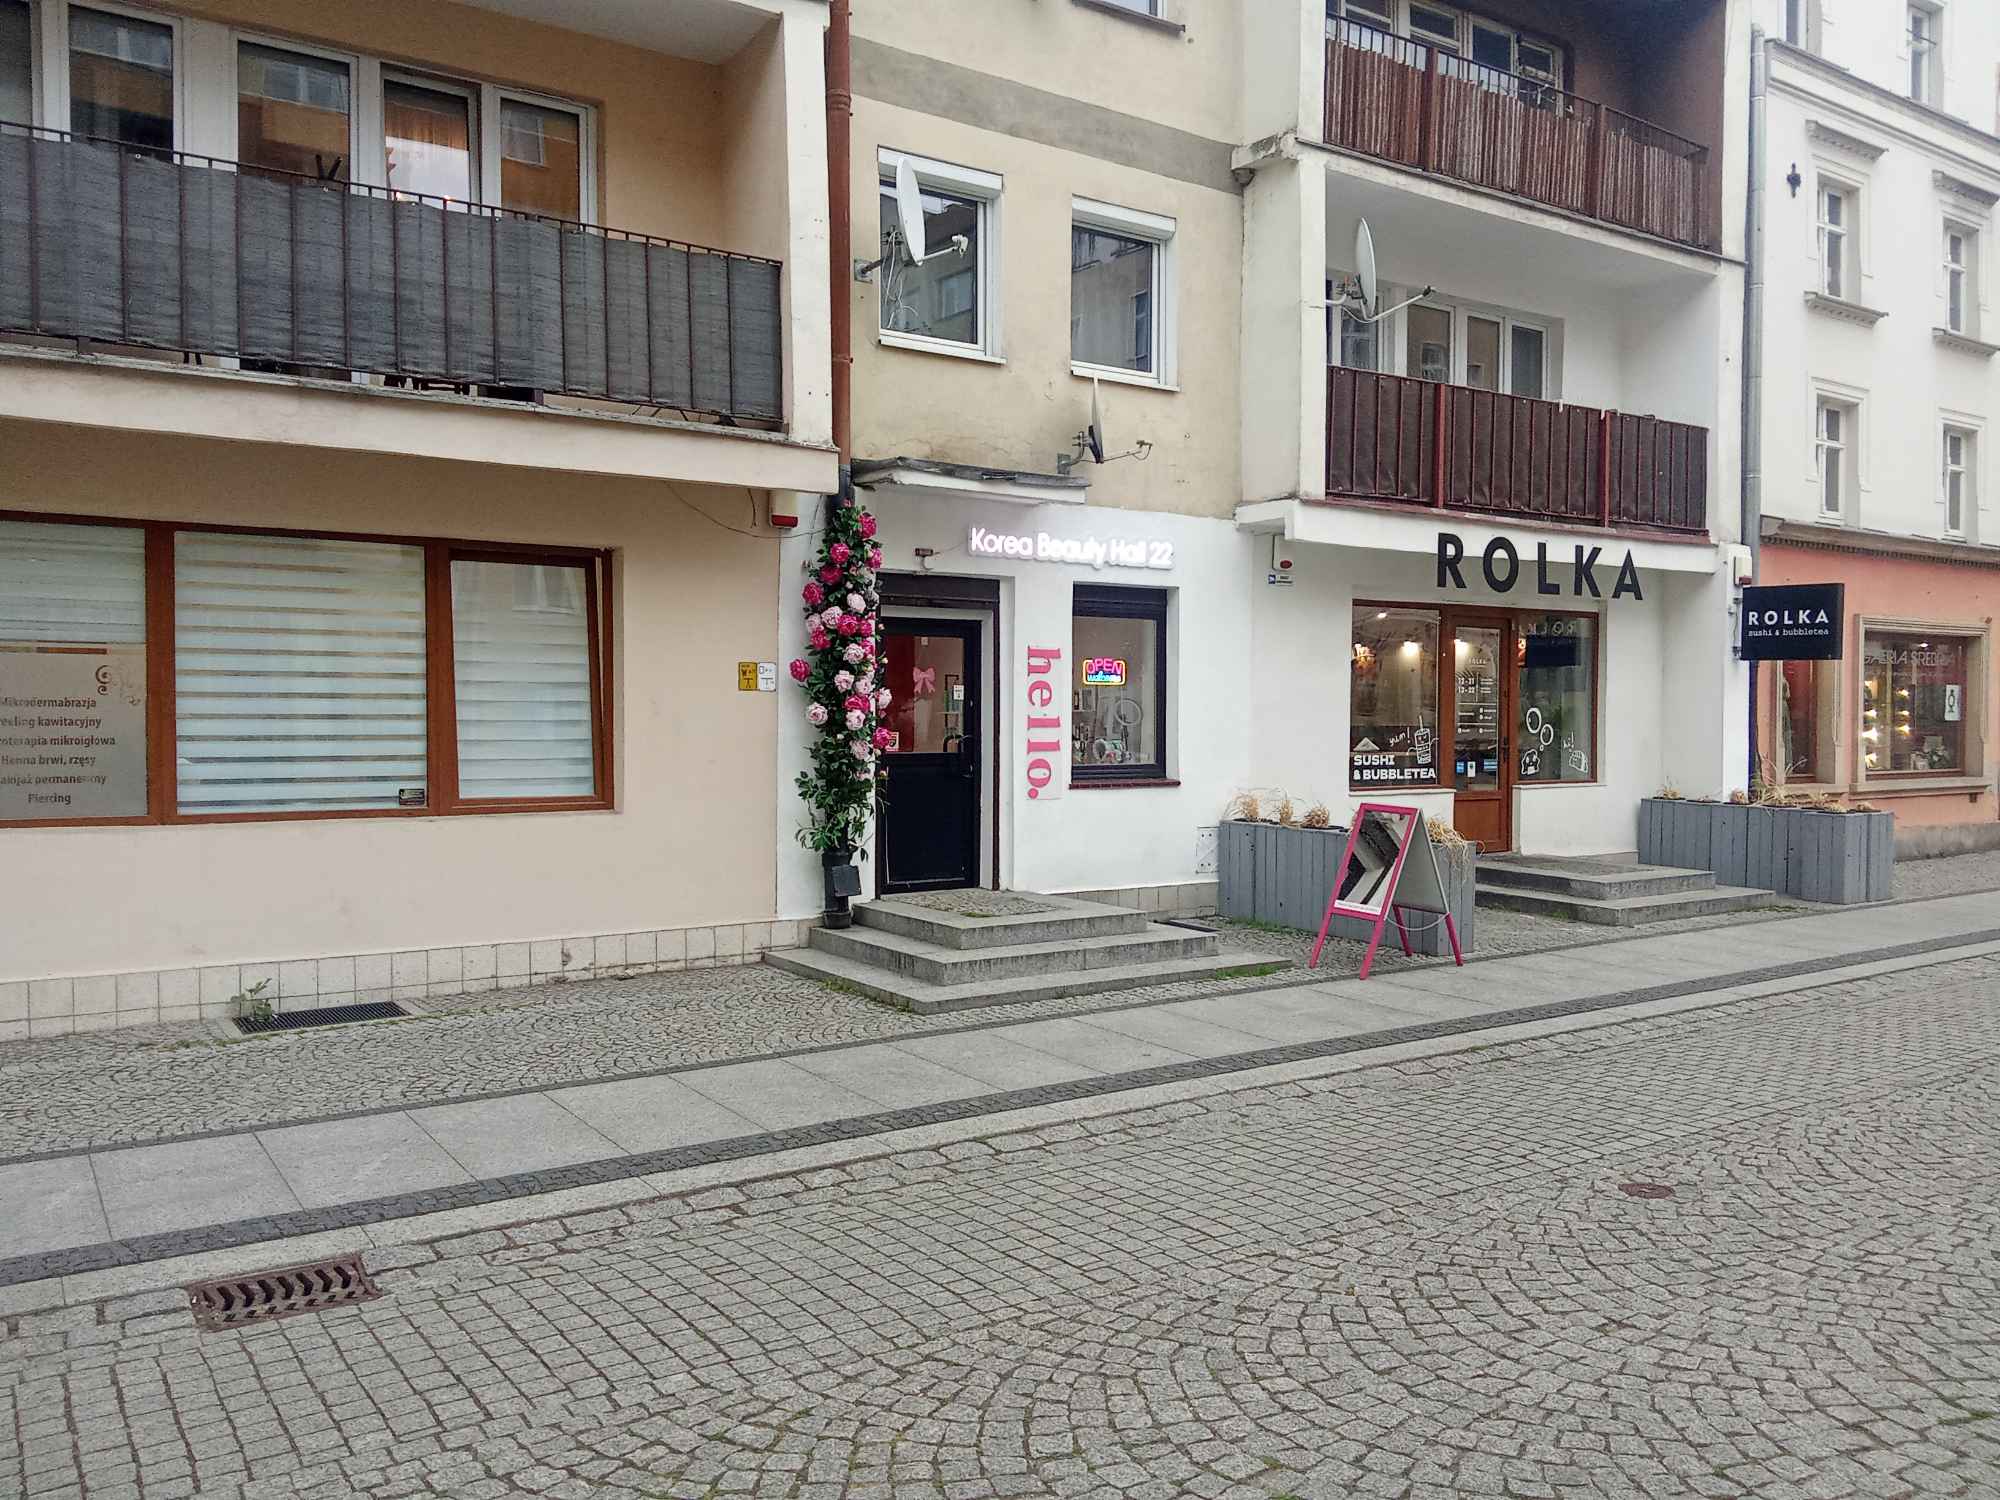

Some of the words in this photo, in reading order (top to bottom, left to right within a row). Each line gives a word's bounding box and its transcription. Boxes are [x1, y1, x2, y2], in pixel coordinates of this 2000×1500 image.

[971, 528, 1033, 556] Korea
[1037, 532, 1107, 569] Beauty
[1149, 541, 1174, 566] 22
[1436, 532, 1643, 600] ROLKA
[1748, 608, 1829, 625] ROLKA
[1748, 628, 1772, 636] sushi
[1782, 628, 1829, 636] bubbletea
[1086, 658, 1122, 674] OPEN
[38, 716, 101, 728] kawitacyjny
[1026, 645, 1061, 799] hello.
[1353, 754, 1395, 766] SUSHI
[1353, 769, 1361, 780] &
[1362, 768, 1436, 780] BUBBLETEA
[28, 793, 71, 805] Piercing
